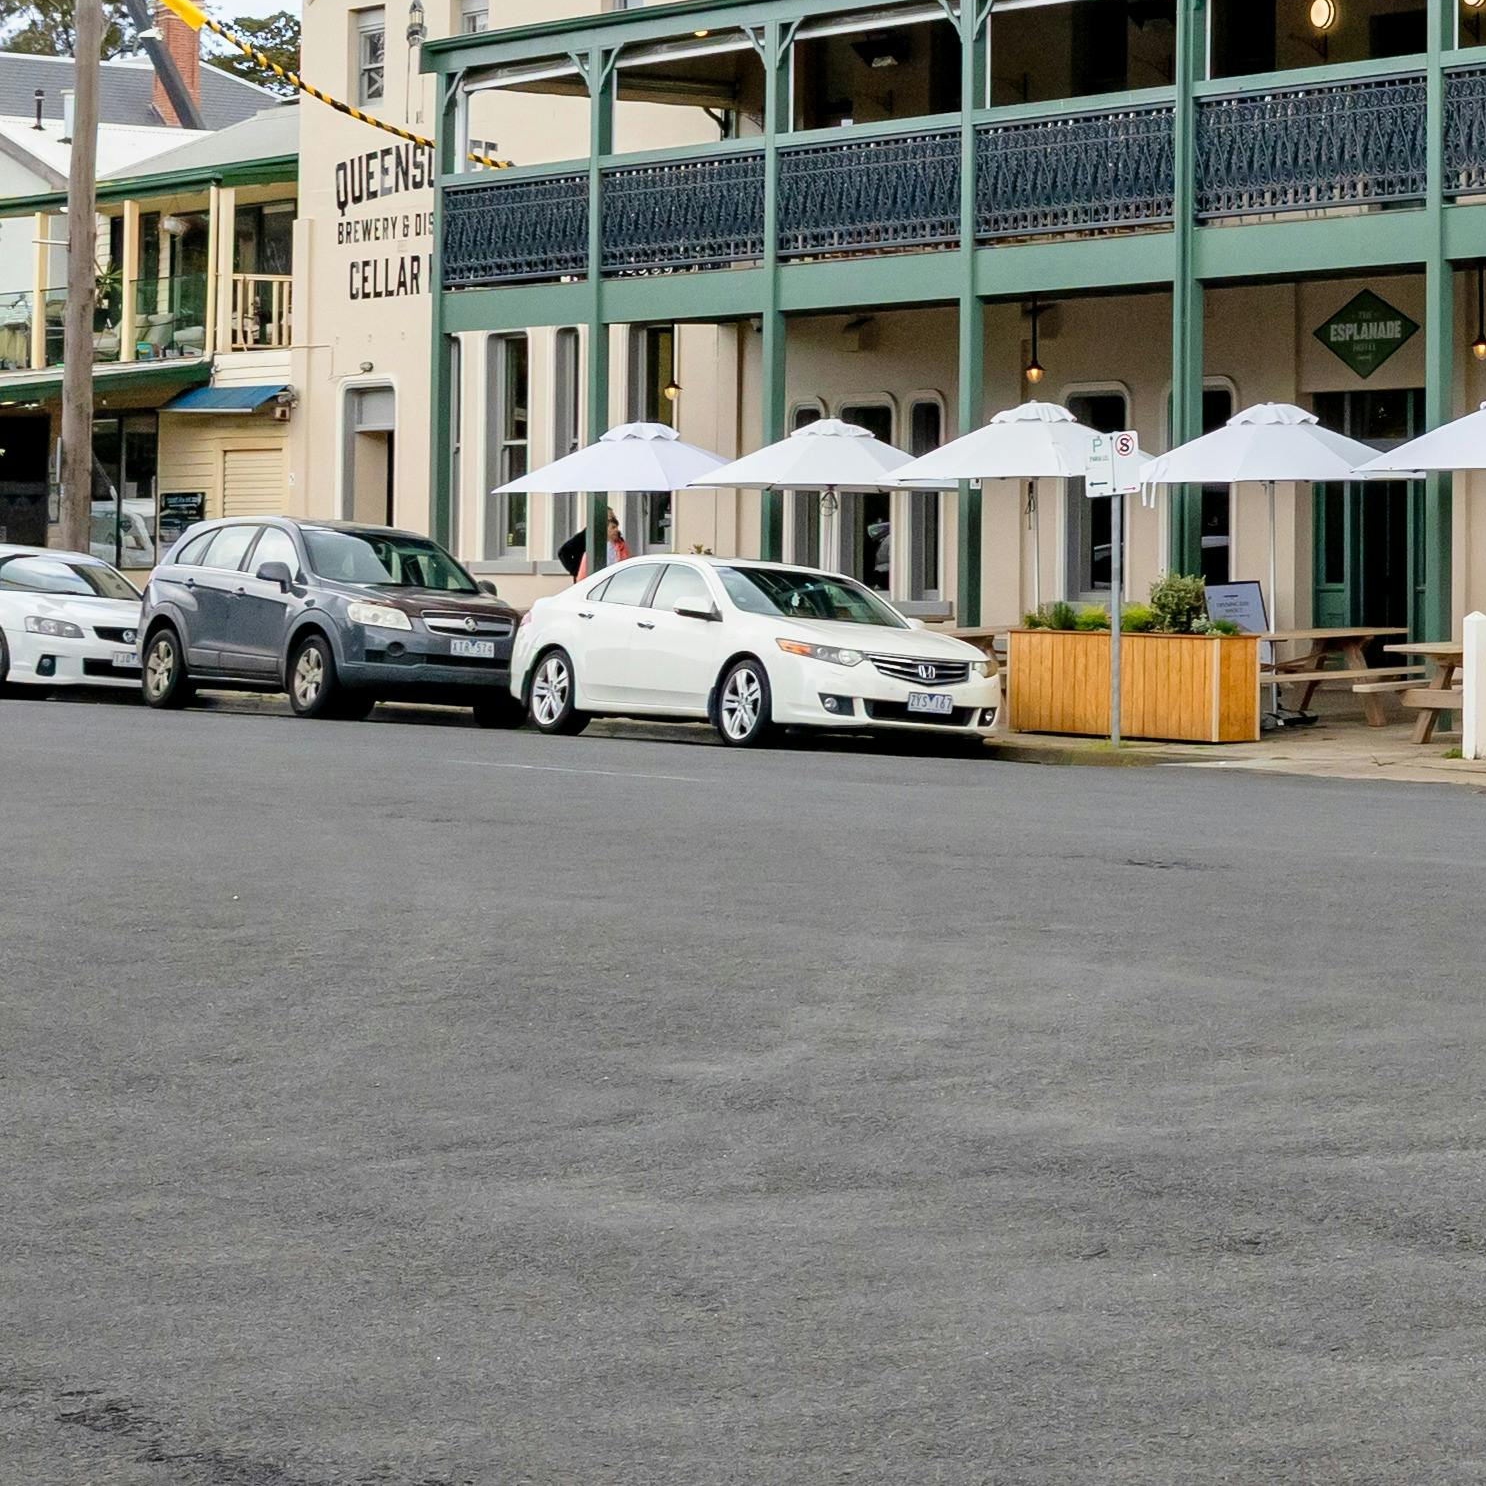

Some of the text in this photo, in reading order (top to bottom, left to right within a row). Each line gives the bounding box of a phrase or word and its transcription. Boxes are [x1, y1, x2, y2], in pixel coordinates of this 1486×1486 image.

[337, 217, 398, 245] BREWERY
[402, 216, 410, 237] &
[350, 256, 420, 300] CELLAR
[1330, 320, 1402, 342] ESPLANADE
